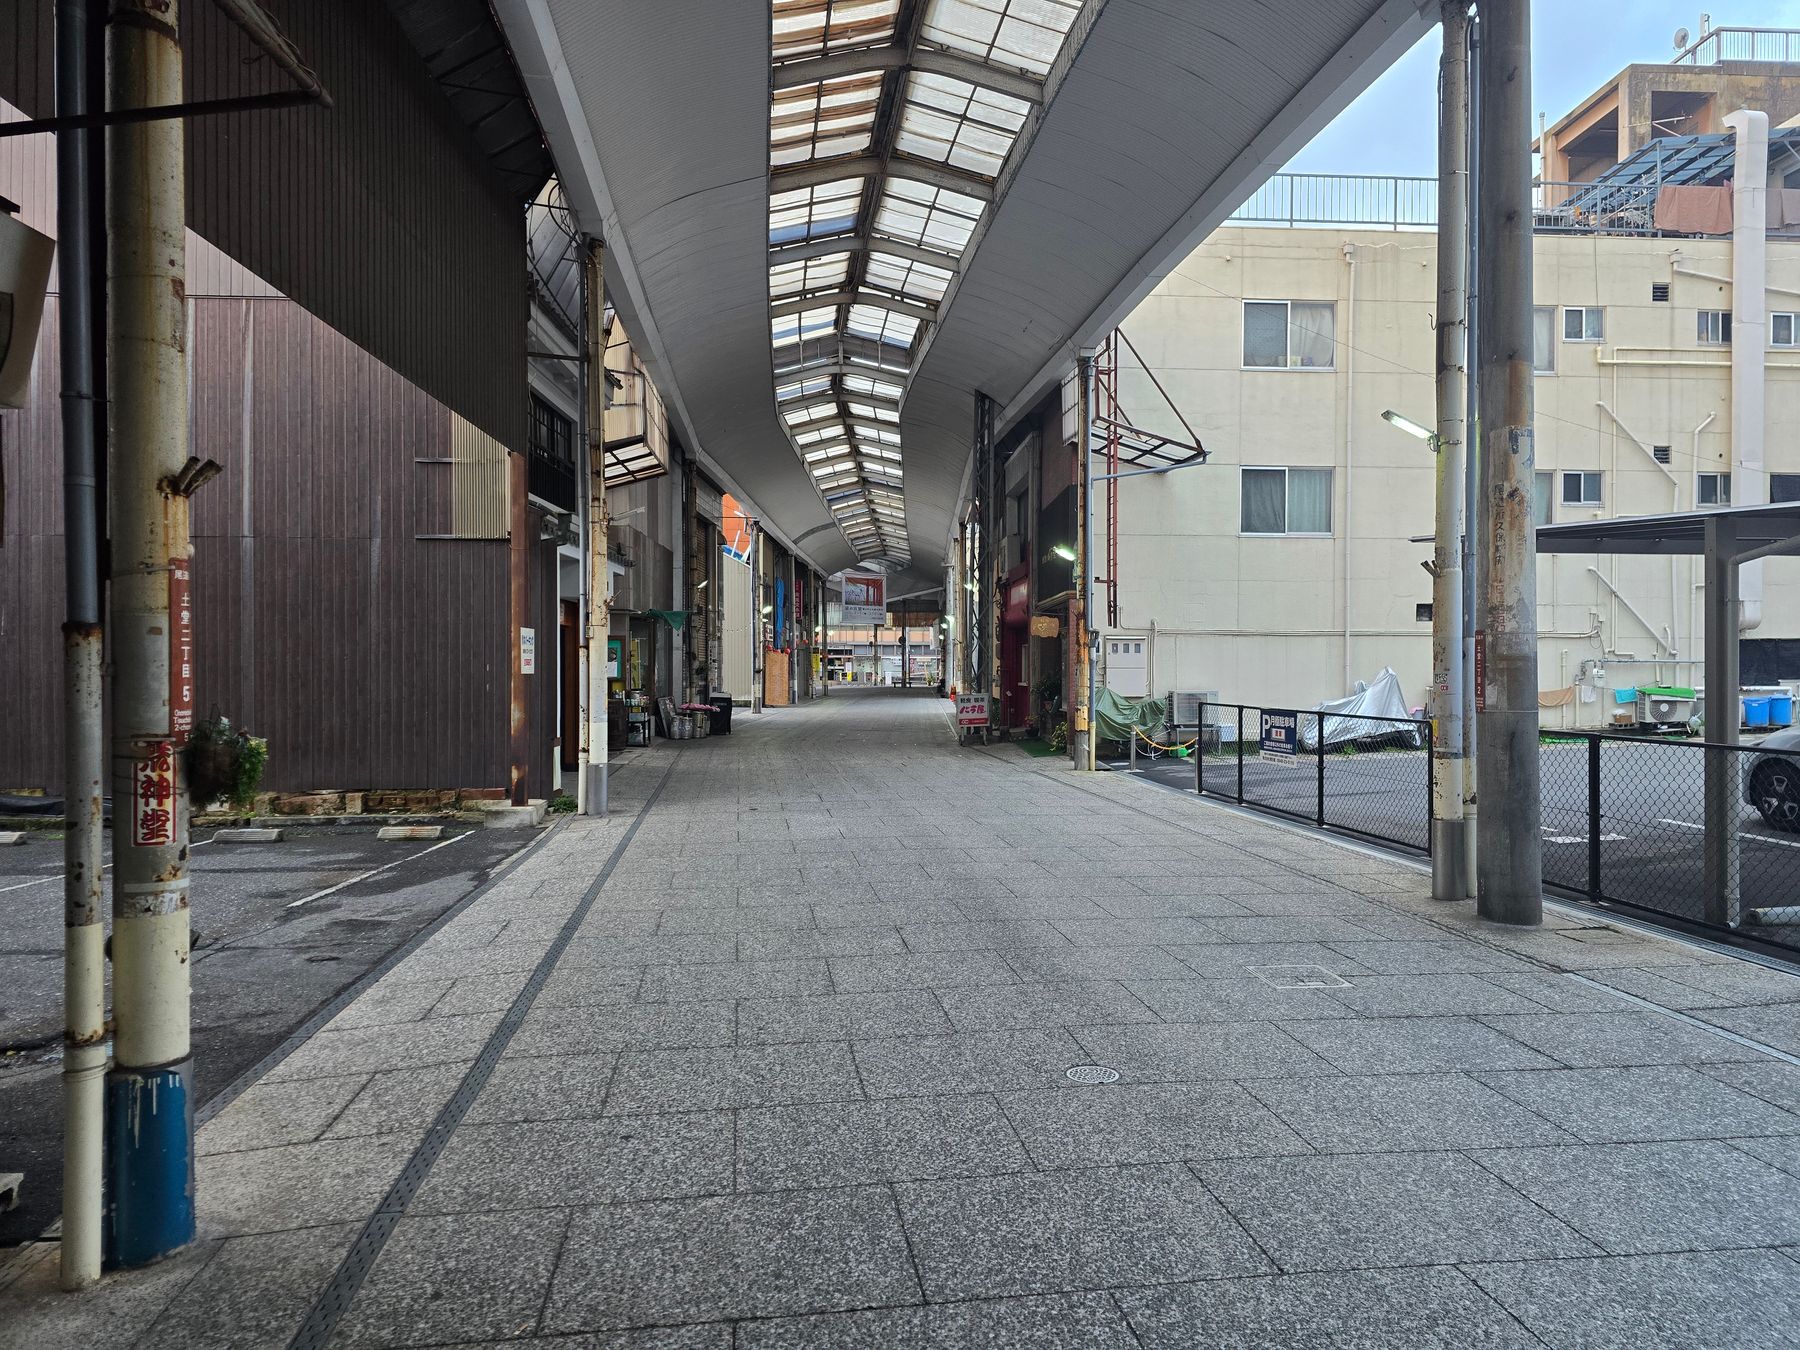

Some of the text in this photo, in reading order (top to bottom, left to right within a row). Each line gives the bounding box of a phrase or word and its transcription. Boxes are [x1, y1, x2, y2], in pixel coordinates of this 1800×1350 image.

[180, 593, 191, 702] 土堂二丁目 5
[1262, 714, 1271, 738] P
